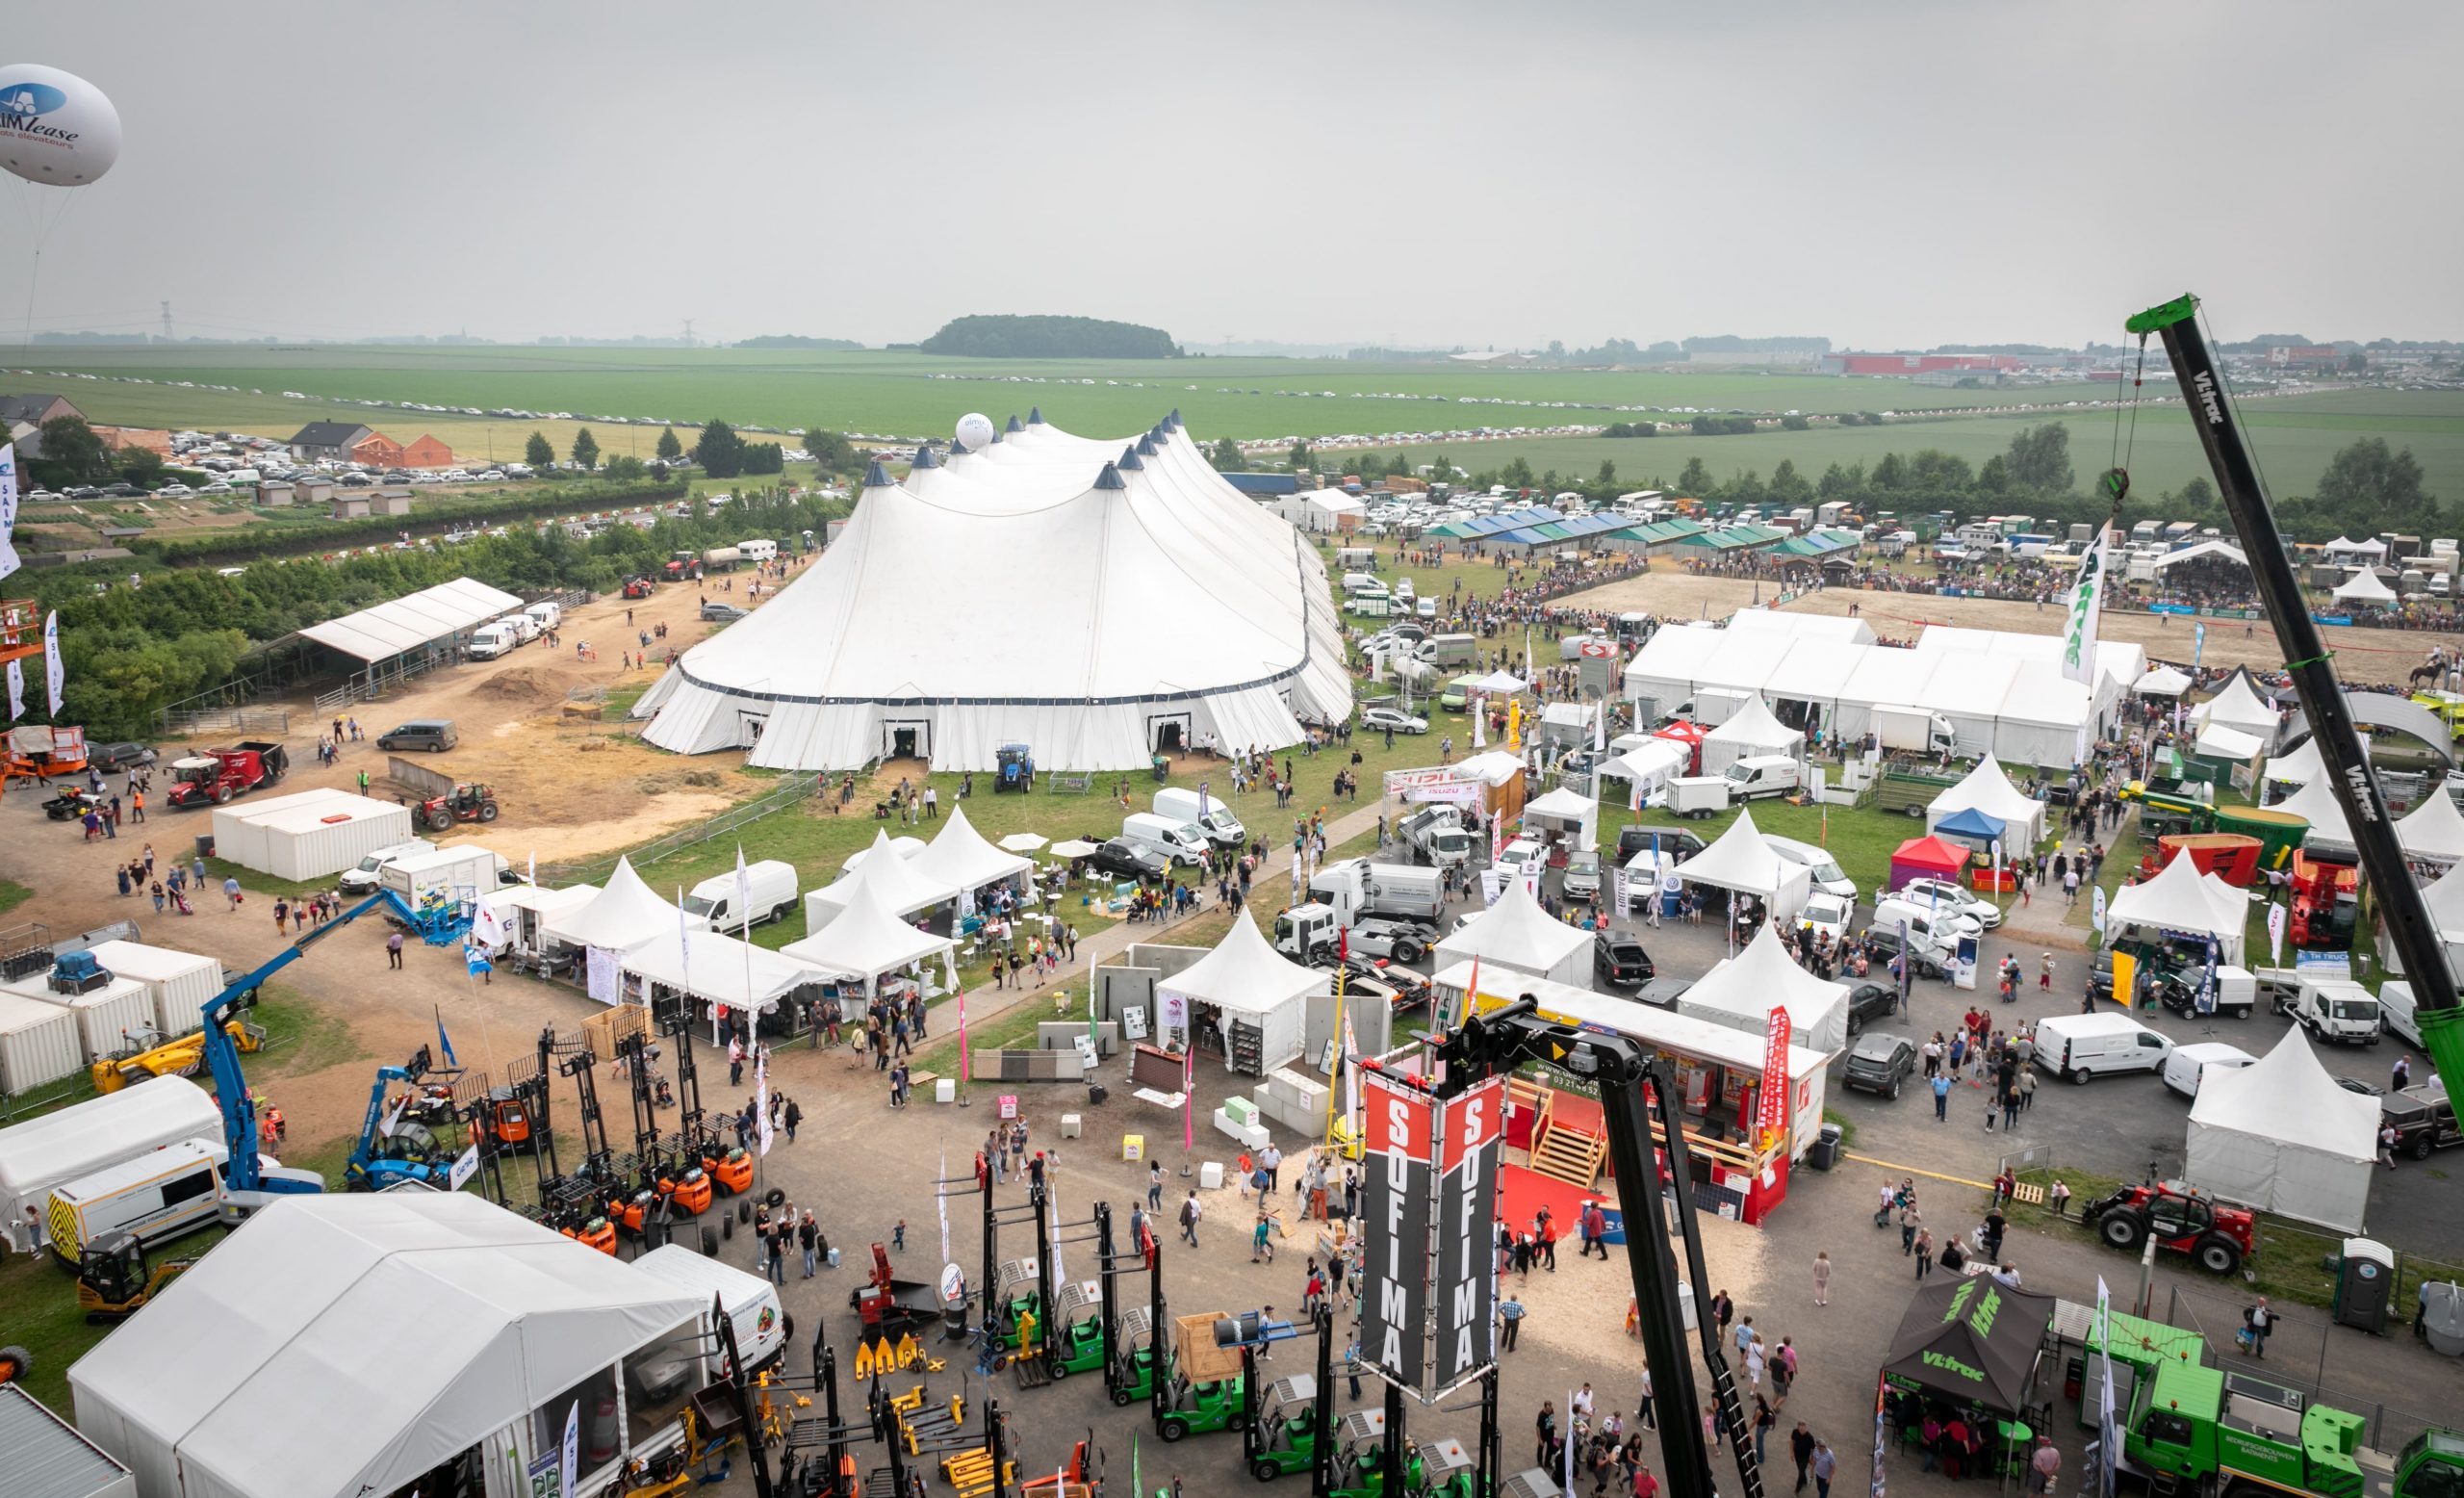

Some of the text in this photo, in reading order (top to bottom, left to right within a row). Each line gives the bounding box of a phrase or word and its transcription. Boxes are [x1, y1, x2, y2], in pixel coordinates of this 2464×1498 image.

[1553, 1075, 1563, 1085] 03
[1566, 1079, 1575, 1088] 21
[1588, 1087, 1598, 1096] 52
[1380, 1099, 1409, 1375] SOFIMA
[1453, 1098, 1483, 1374] SOFIMA
